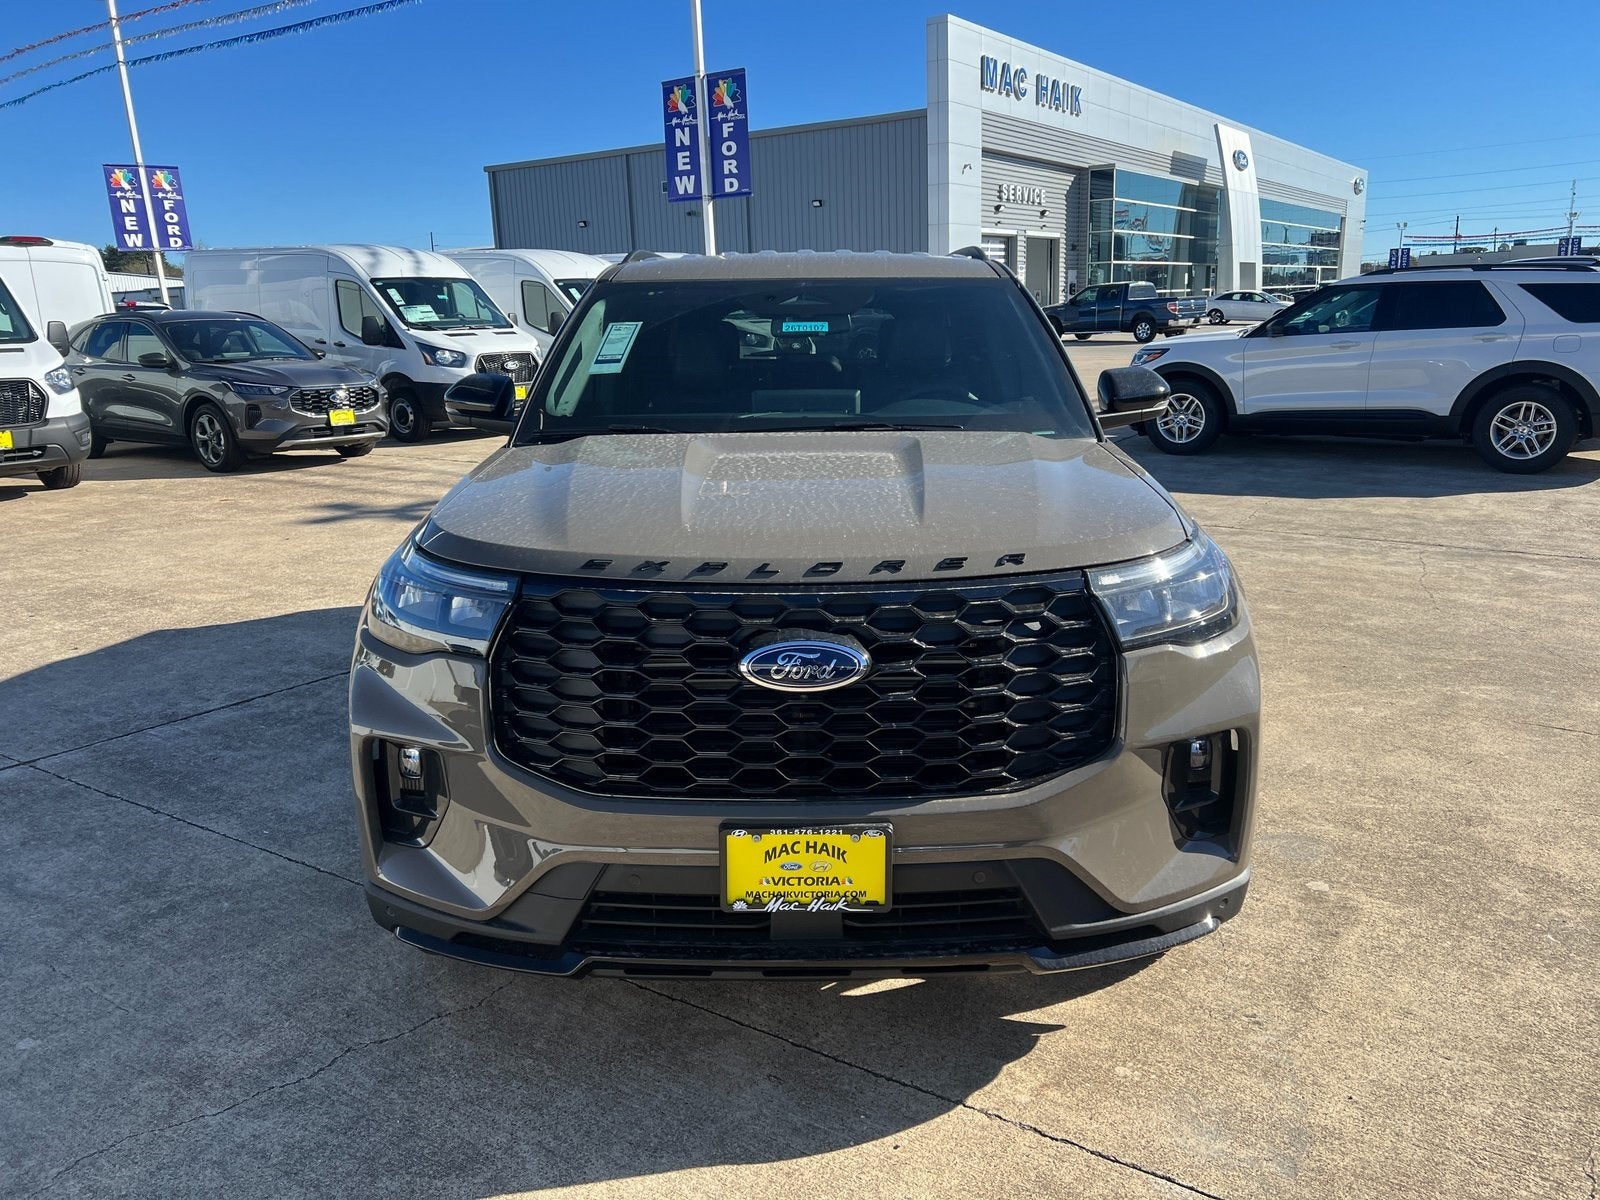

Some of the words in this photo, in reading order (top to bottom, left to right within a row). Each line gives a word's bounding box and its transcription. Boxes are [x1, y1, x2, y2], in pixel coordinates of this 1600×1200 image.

[981, 55, 1027, 101] MAC
[1036, 74, 1082, 117] HAIK
[674, 127, 695, 195] NEW
[721, 122, 739, 193] FORD
[1001, 183, 1046, 205] SERVICE
[120, 199, 143, 248] NEW
[163, 199, 183, 248] FORD
[580, 553, 1026, 577] EXPLORER
[770, 651, 837, 680] Ford
[764, 841, 800, 864] MAC
[805, 841, 847, 864] HAIK
[745, 890, 867, 899] MACHAIKVICTORIA.COM
[771, 876, 841, 887] VICTORIA
[763, 896, 802, 912] Mac
